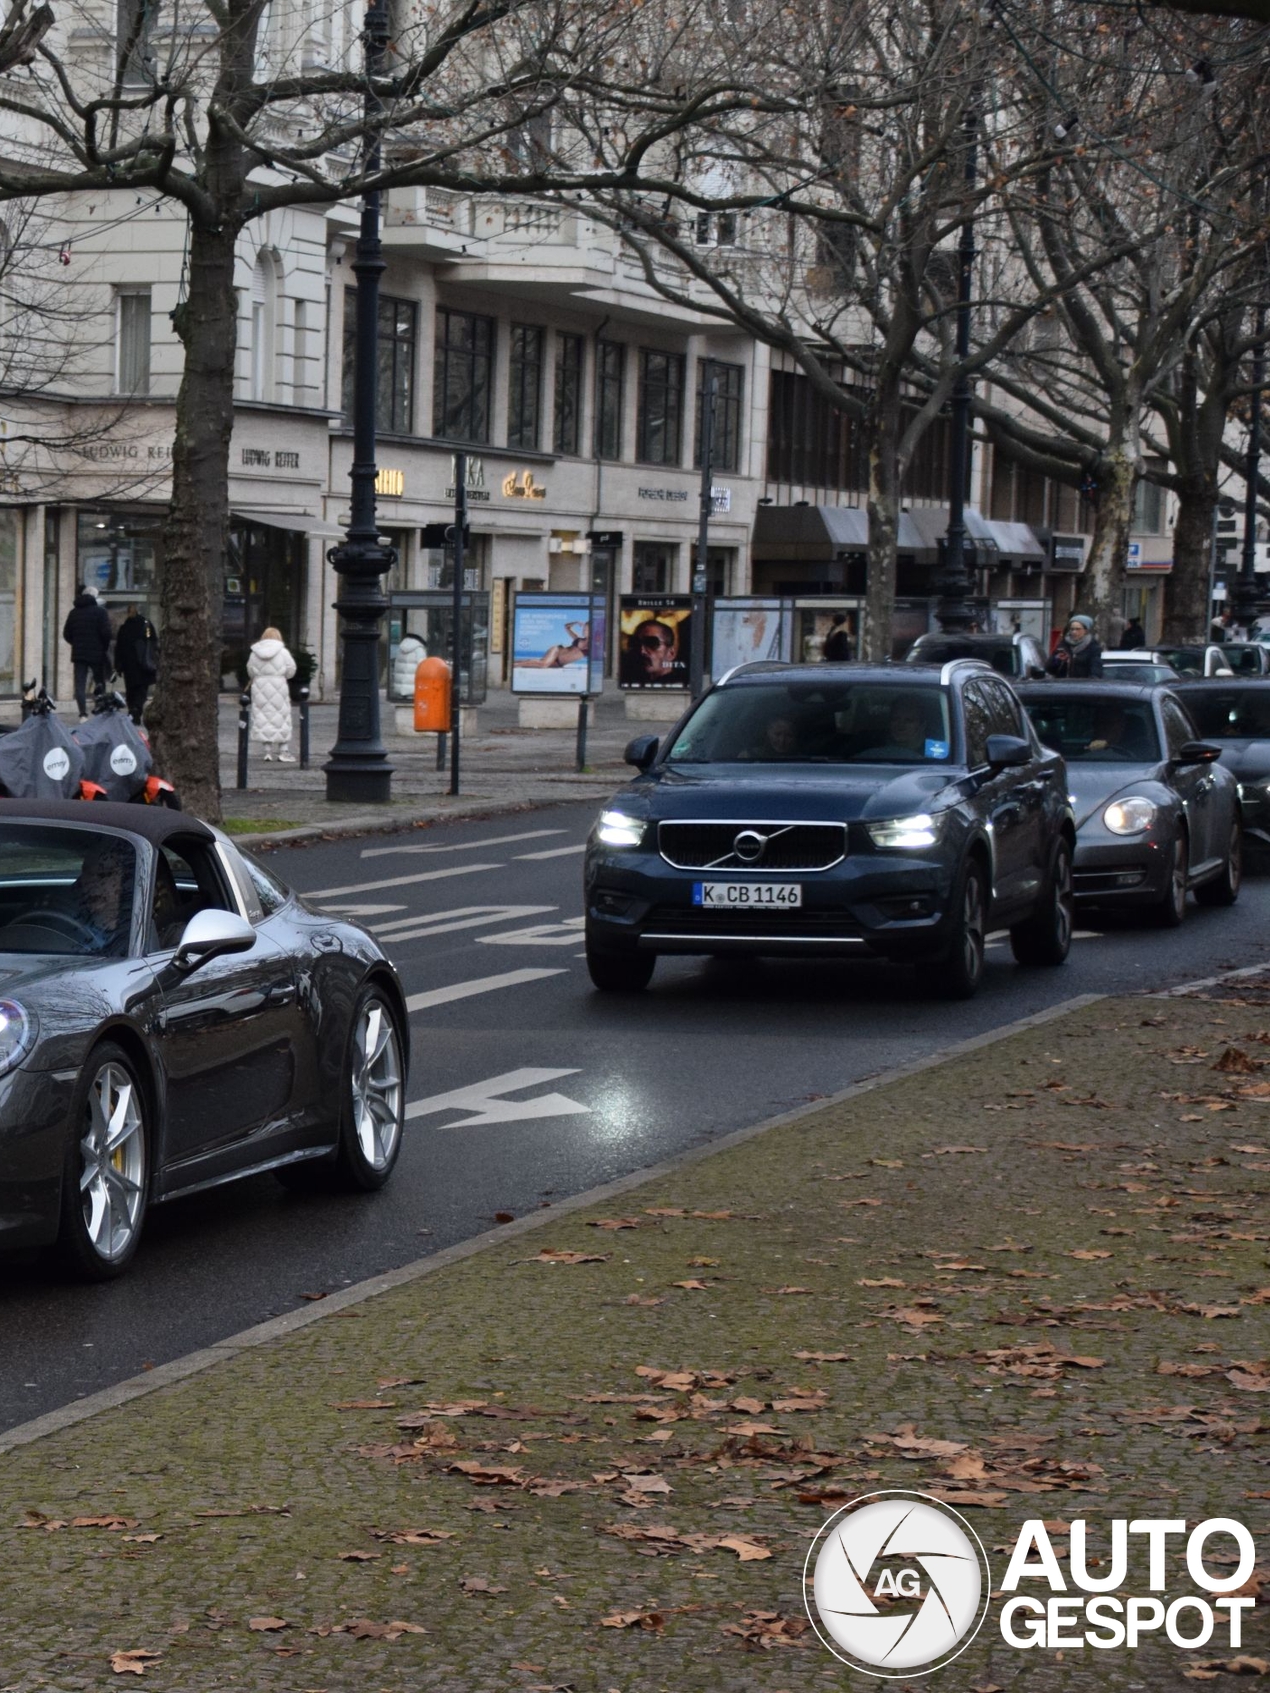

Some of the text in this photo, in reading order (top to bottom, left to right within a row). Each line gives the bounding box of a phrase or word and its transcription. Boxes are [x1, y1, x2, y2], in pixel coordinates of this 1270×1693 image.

[82, 446, 174, 459] LUDWIG REI
[241, 448, 271, 467] LUDWIG
[703, 886, 715, 903] K
[753, 886, 798, 904] 1146
